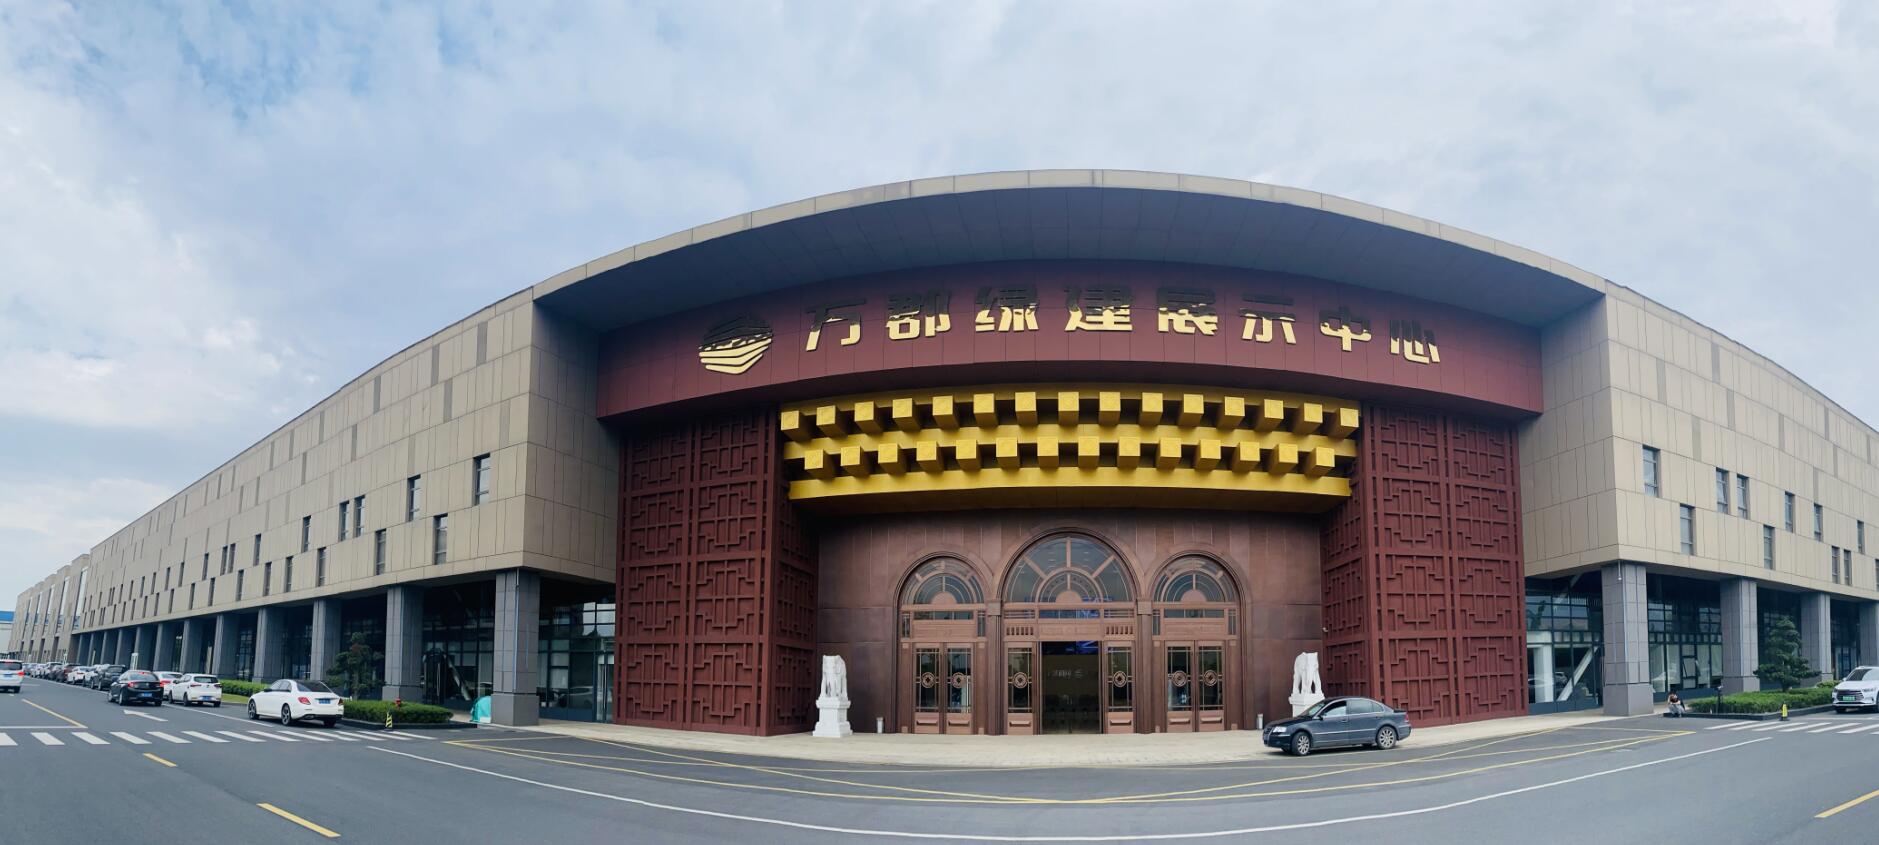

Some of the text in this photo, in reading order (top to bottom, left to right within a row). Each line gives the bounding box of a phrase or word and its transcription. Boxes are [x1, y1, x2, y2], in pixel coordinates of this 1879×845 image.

[804, 283, 1441, 364] 万都绿建展示中心
